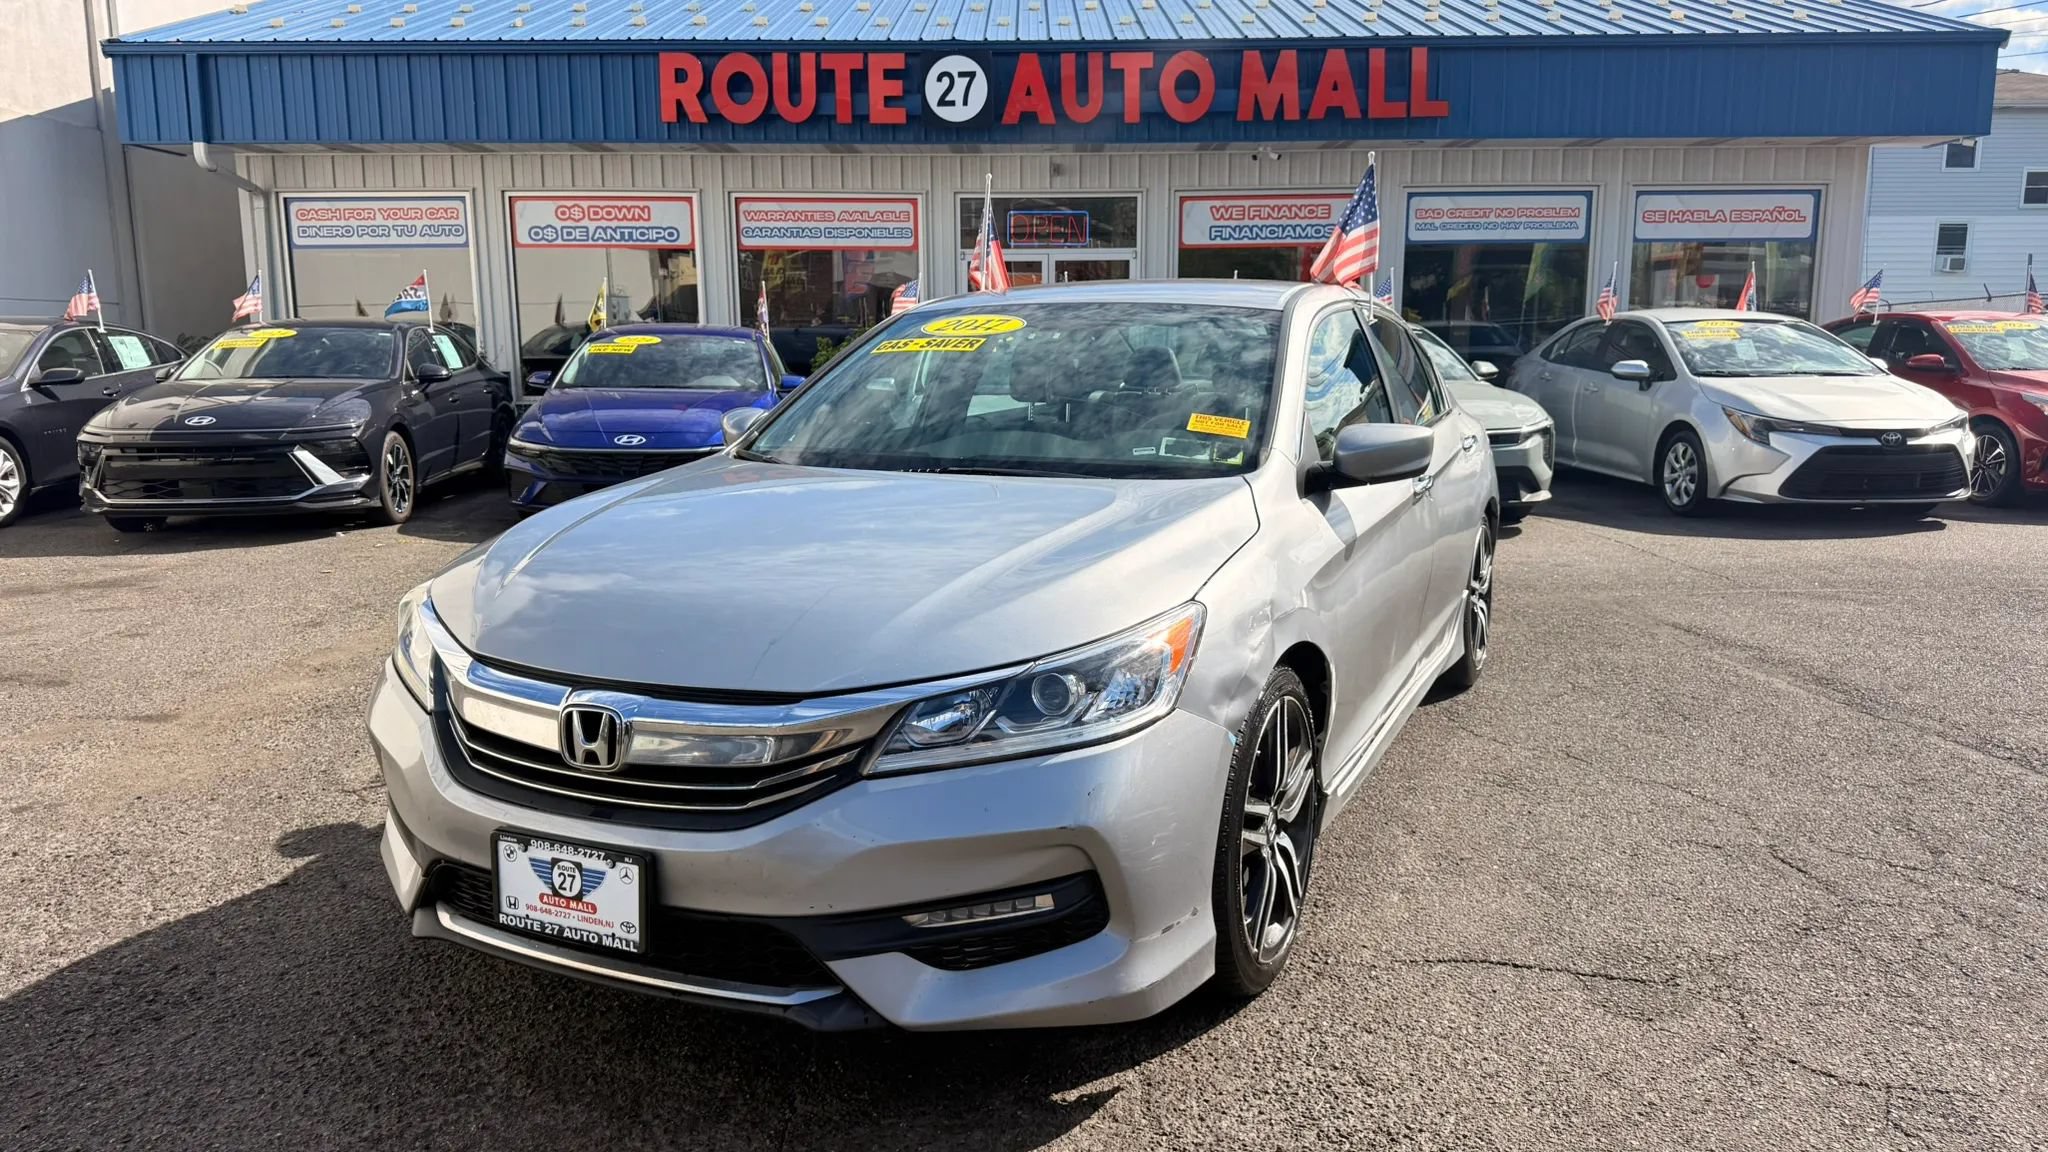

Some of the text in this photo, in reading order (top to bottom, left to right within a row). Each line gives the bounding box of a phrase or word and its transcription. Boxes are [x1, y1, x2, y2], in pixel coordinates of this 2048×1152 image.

[659, 47, 1449, 125] ROUTE 27 AUTO MALL
[296, 207, 459, 221] CASH FOR YOUR CAR
[588, 205, 651, 221] DOWN
[743, 210, 910, 222] WARRANTIES AVAILABLE
[1210, 204, 1331, 221] WE FINANCE
[1415, 207, 1580, 219] BAD CREDIT NO PROBLEM
[1643, 206, 1806, 223] SE HABLA ESPAÑOL
[297, 224, 464, 238] DINERO POR TU AUTO
[560, 226, 589, 242] DE
[591, 226, 680, 242] ANTICIPO
[742, 226, 912, 239] GARANTIAS DISPONIBLES
[1011, 215, 1087, 243] OPEN
[1209, 224, 1336, 241] FINANCIAMOS
[1415, 221, 1579, 231] MAL CREDITO NO HAY PROBLEMA
[934, 319, 1011, 332] 2017
[500, 834, 517, 842] Linden
[531, 840, 605, 860] 908-648-2727
[557, 864, 576, 874] ROUTE
[558, 872, 576, 892] 27
[526, 903, 571, 919] 908-648-2727
[543, 895, 594, 913] AUTO MALL
[499, 914, 638, 952] ROUTE 27 AUTO MALL
